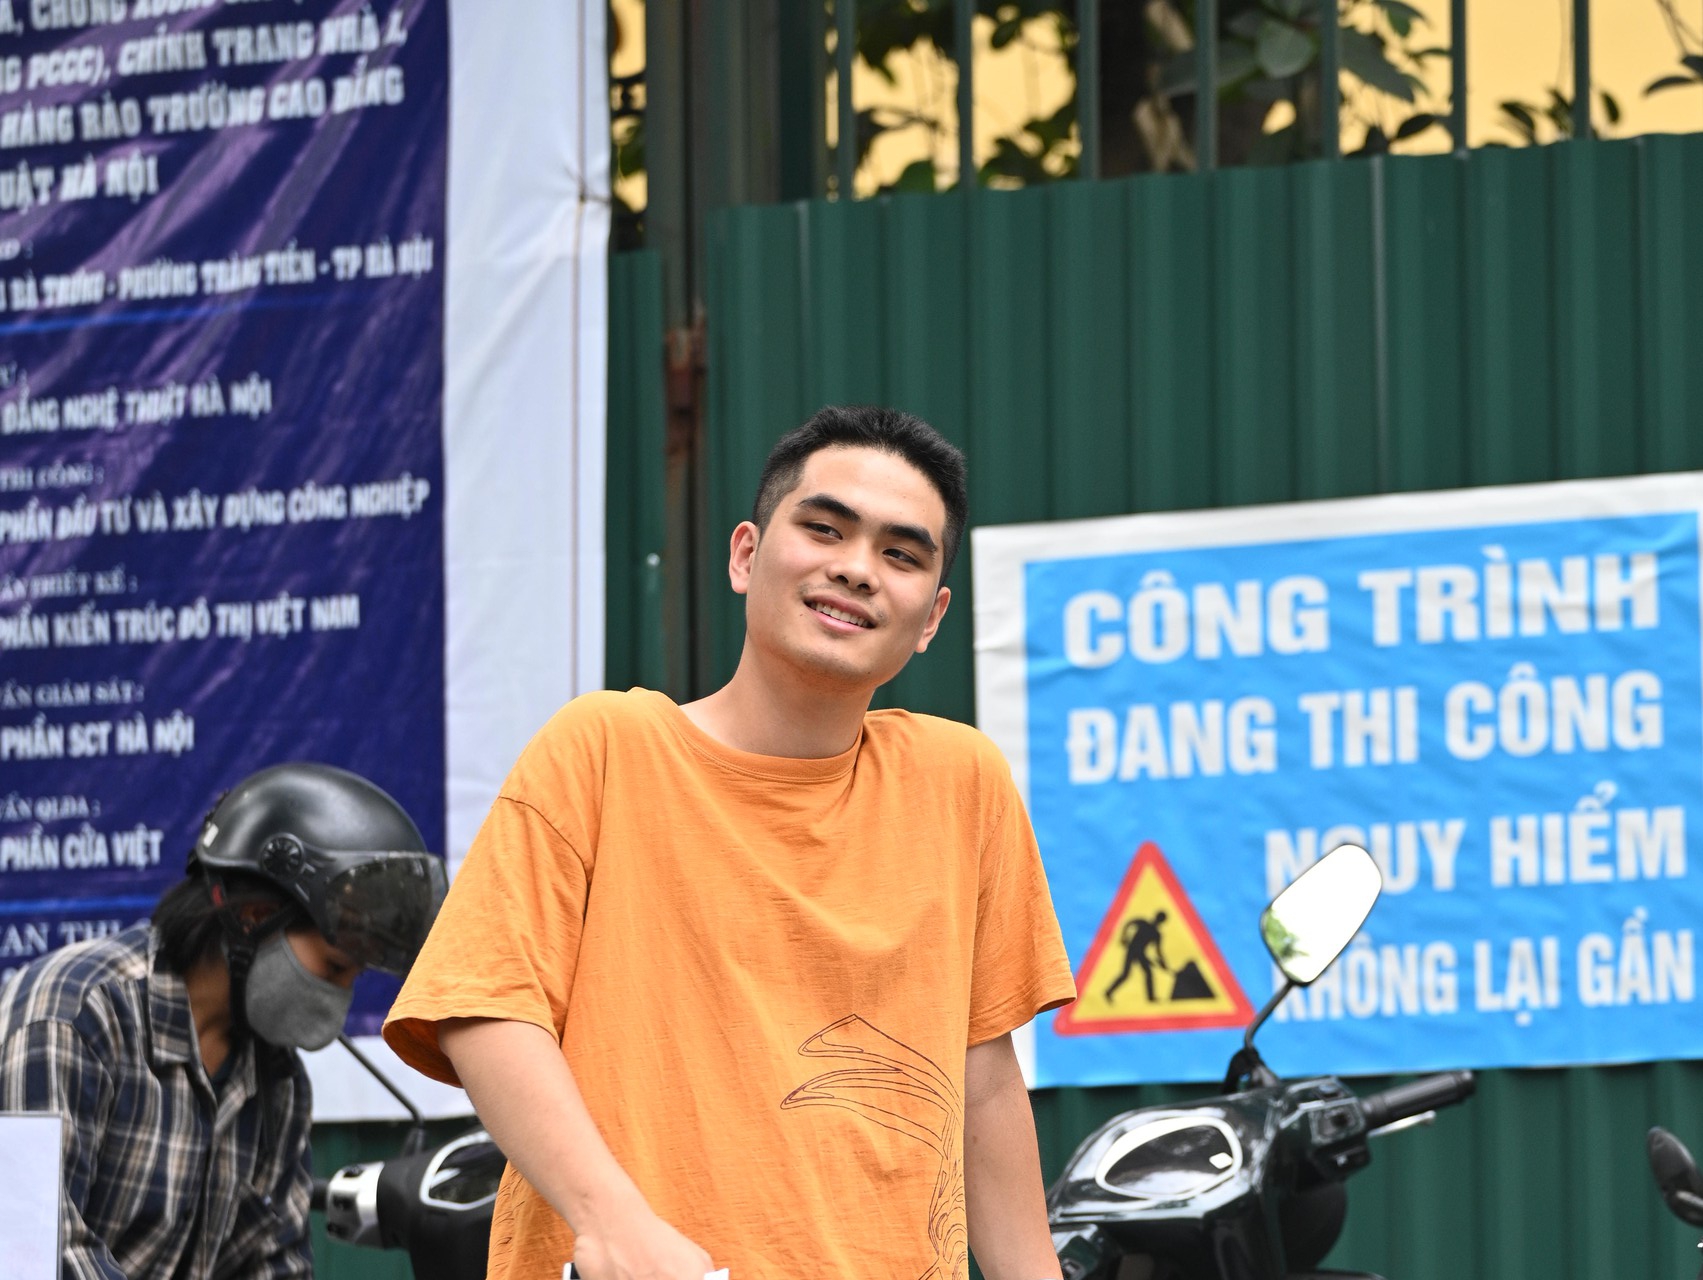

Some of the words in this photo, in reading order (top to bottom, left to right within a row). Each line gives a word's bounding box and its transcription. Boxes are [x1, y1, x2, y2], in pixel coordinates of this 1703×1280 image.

[211, 20, 315, 68] TRANG
[267, 77, 327, 121] CAO
[103, 147, 160, 205] NỘI
[331, 244, 363, 282] TP
[229, 370, 273, 421] NỘI
[134, 489, 168, 533] VÀ
[287, 478, 347, 525] CÔNG
[310, 593, 362, 632] NAM
[1063, 571, 1330, 670] CÔNG
[1358, 545, 1660, 648] TRÌNH
[67, 718, 113, 758] SCT
[116, 710, 150, 755] HÀ
[152, 707, 195, 758] NỘI
[1066, 697, 1278, 785] ĐANG
[1299, 686, 1420, 770] THI
[1444, 662, 1665, 762] CÔNG
[1265, 819, 1466, 900] NUY
[1489, 781, 1688, 888] HIỂM
[1474, 937, 1561, 1027] LẠI
